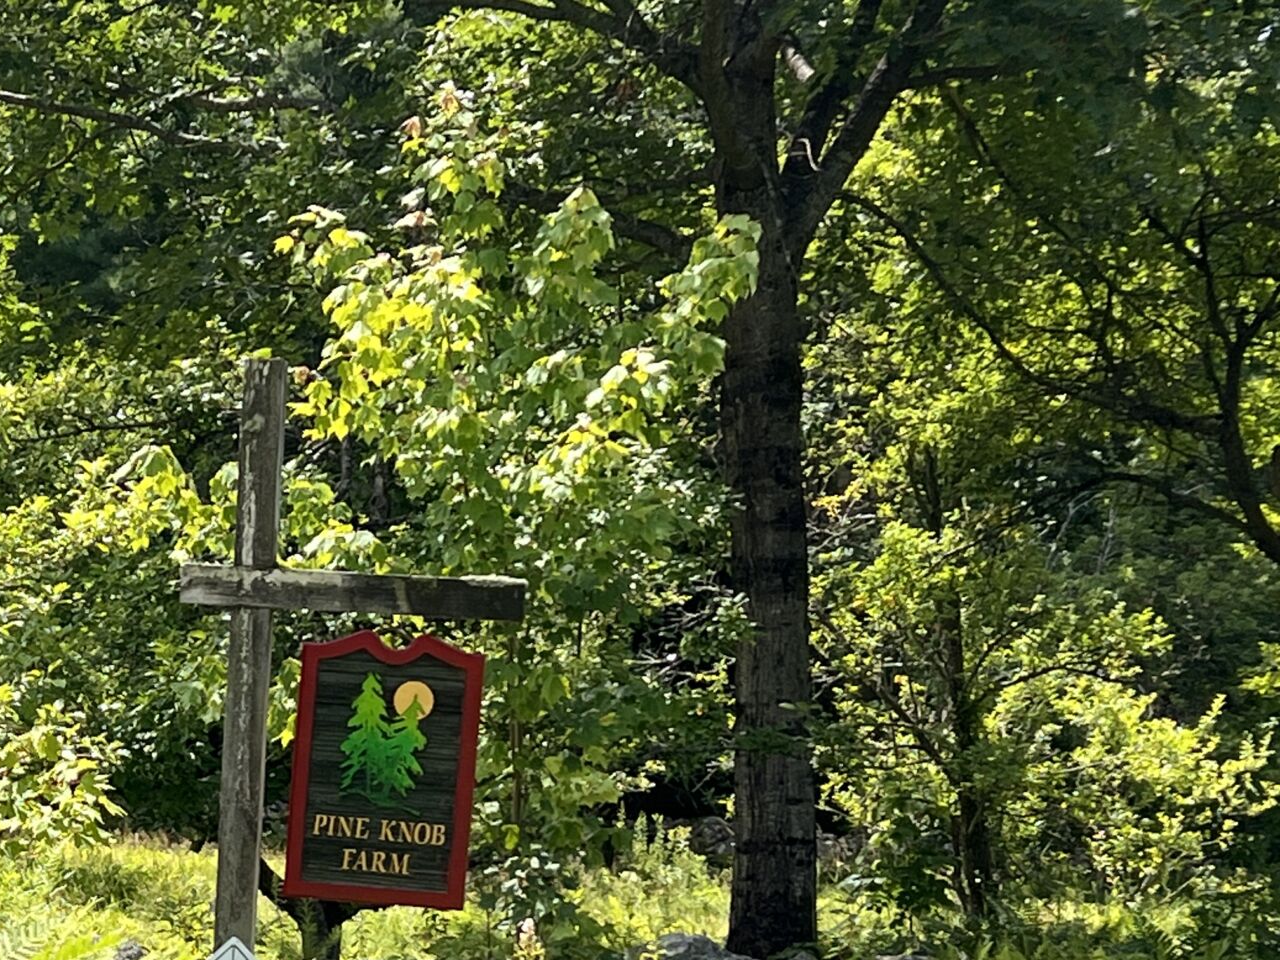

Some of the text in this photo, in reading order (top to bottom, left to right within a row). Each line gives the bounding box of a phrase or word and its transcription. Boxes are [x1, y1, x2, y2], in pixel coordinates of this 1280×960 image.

[312, 814, 447, 846] PINE KNOB
[340, 848, 411, 876] FARM
